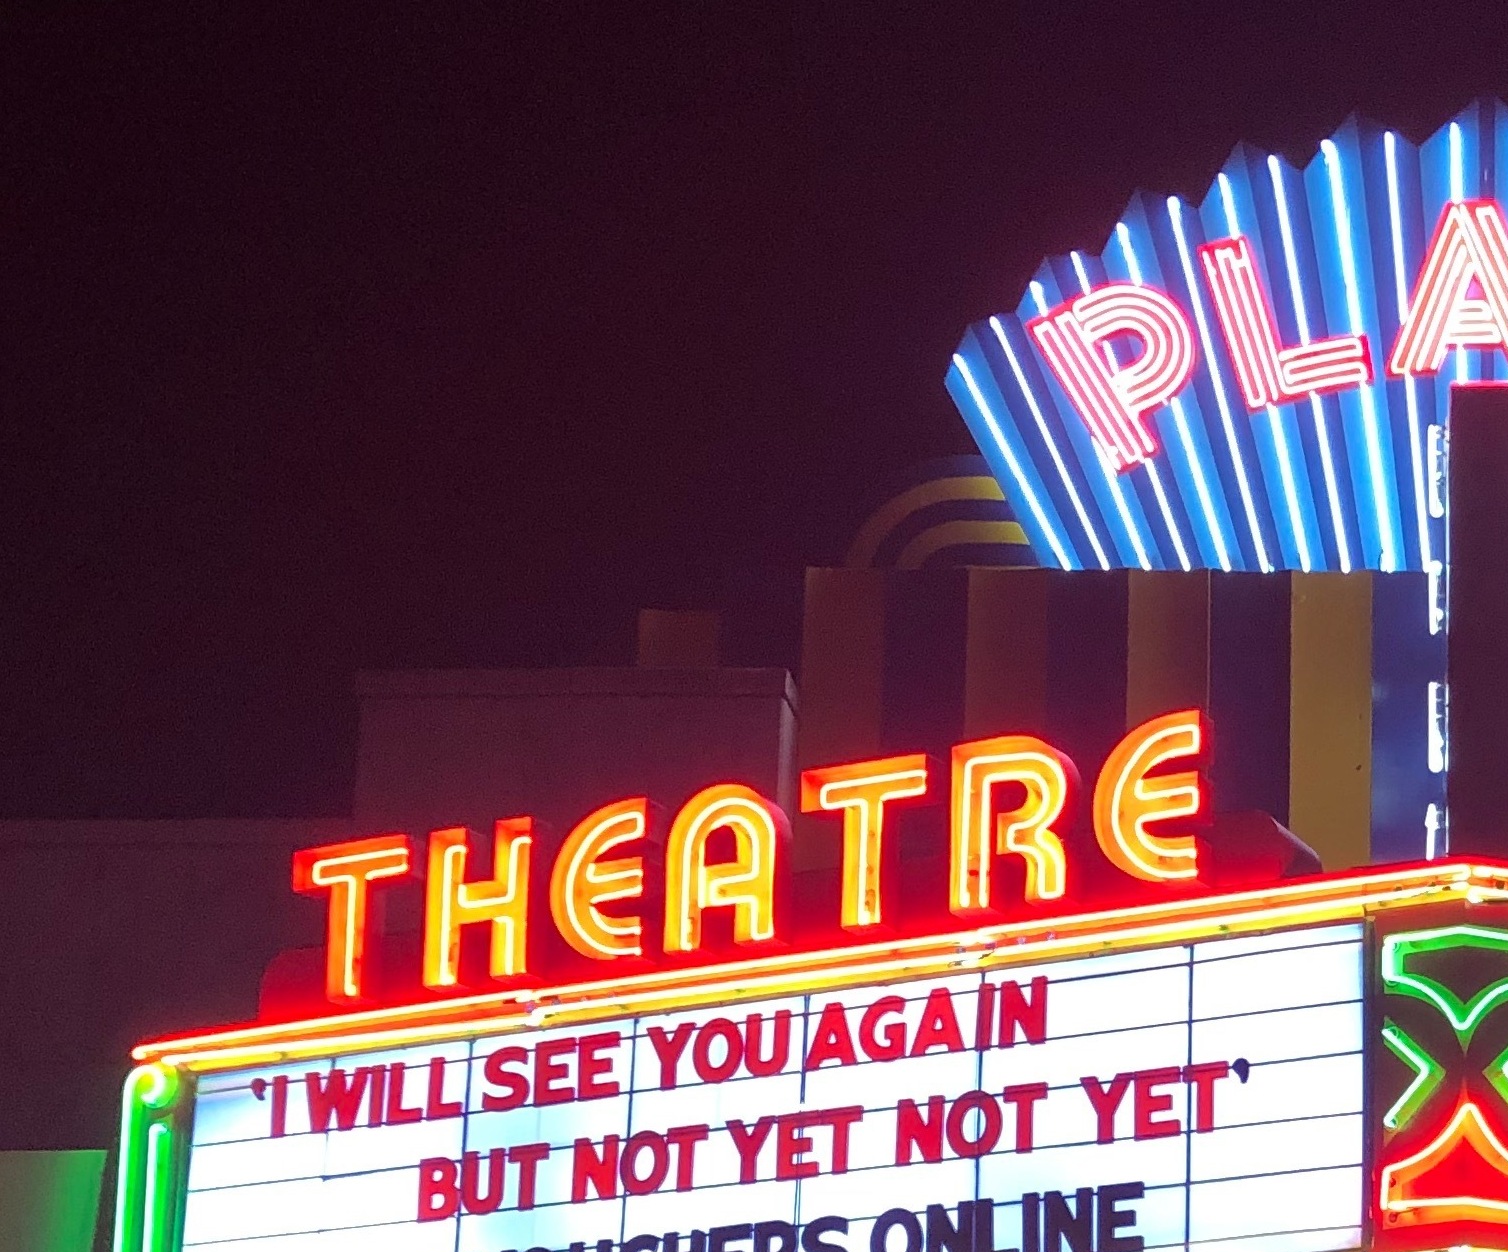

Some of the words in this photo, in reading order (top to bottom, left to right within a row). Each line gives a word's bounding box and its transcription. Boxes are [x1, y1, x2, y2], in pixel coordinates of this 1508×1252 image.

[292, 708, 1208, 1003] THEATRE
[305, 1056, 463, 1133] WILL
[482, 1031, 621, 1112] SEE
[647, 1009, 791, 1092] YOU
[804, 976, 1048, 1072] AGAIN
[417, 1142, 551, 1222] BUT
[571, 1123, 709, 1205] NOT
[725, 1105, 864, 1184] YET
[895, 1082, 1048, 1166] NOT
